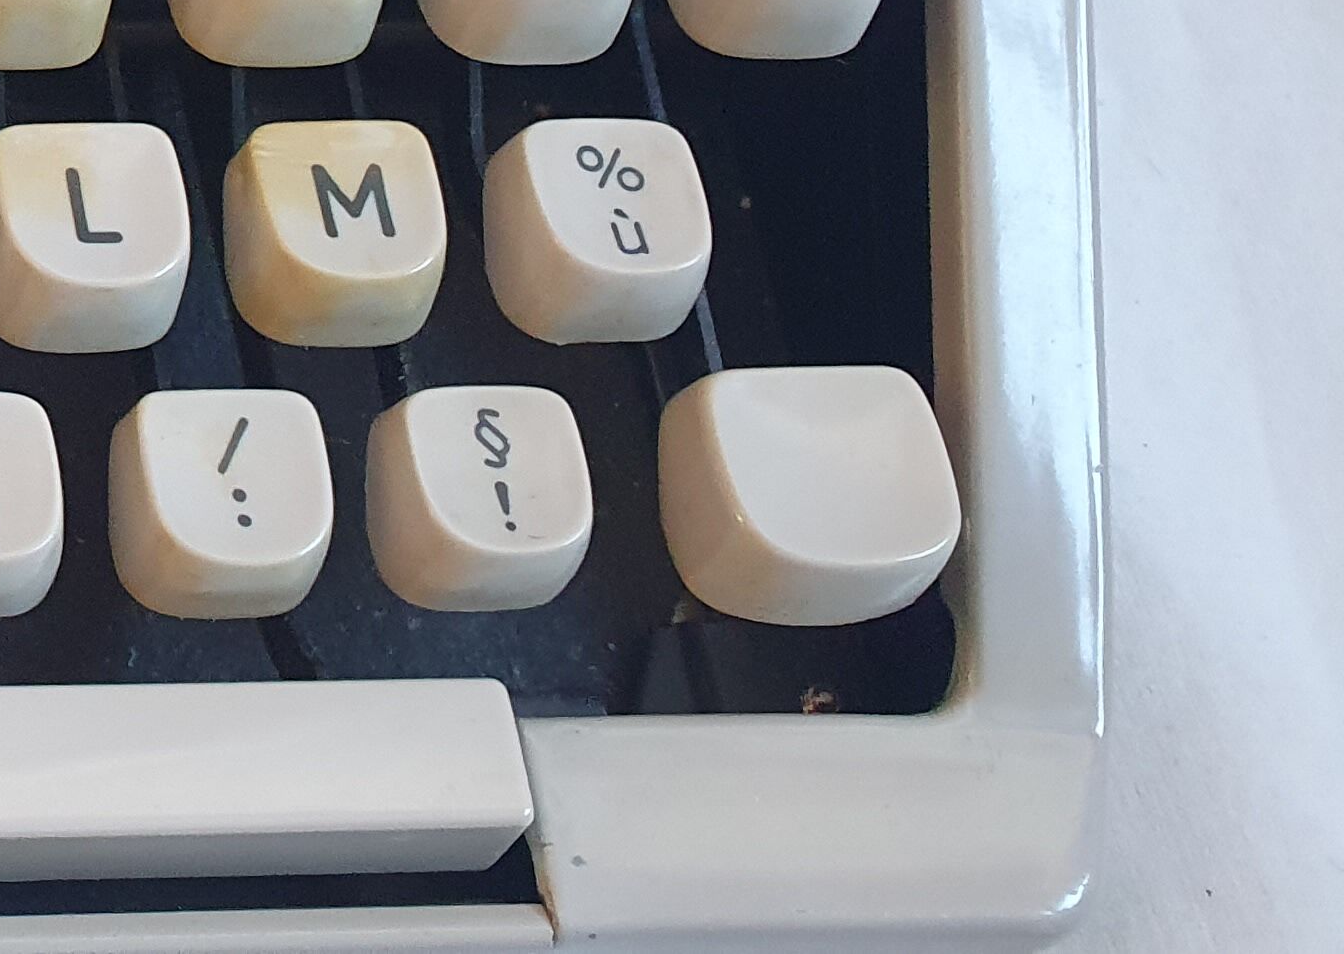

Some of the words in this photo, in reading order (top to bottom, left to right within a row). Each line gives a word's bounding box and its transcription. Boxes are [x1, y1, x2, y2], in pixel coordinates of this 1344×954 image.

[574, 143, 646, 193] %
[63, 166, 125, 245] L
[309, 161, 398, 240] M
[609, 206, 651, 256] ù
[216, 415, 250, 477] /
[472, 406, 512, 471] §
[230, 487, 254, 529] :
[492, 479, 518, 534] !
